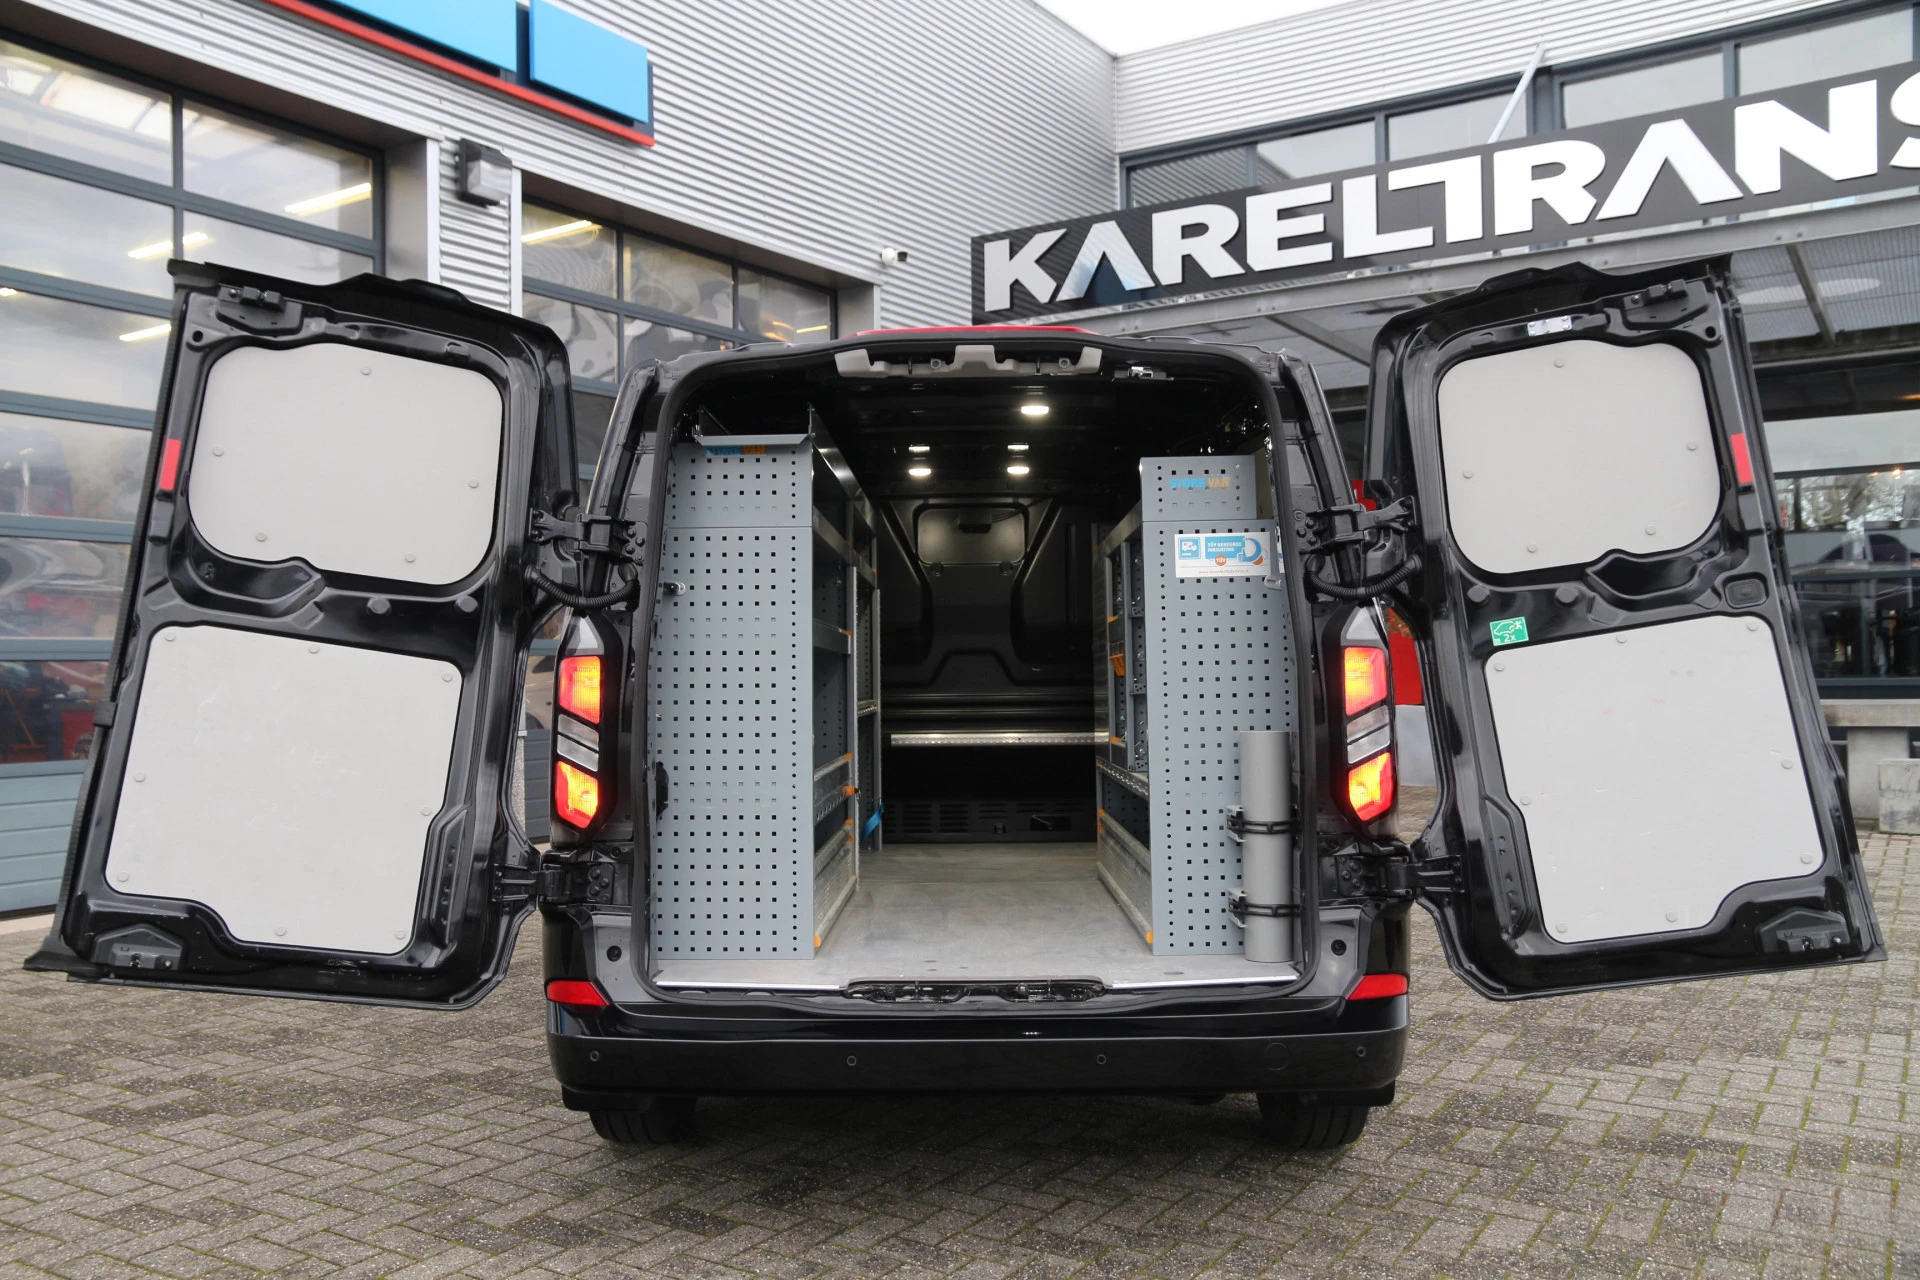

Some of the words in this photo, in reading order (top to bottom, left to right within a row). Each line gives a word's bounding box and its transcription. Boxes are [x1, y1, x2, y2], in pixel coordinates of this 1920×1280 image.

[983, 72, 1920, 312] KARELTRAN
[1169, 478, 1206, 489] STORE
[1207, 478, 1231, 488] VAN
